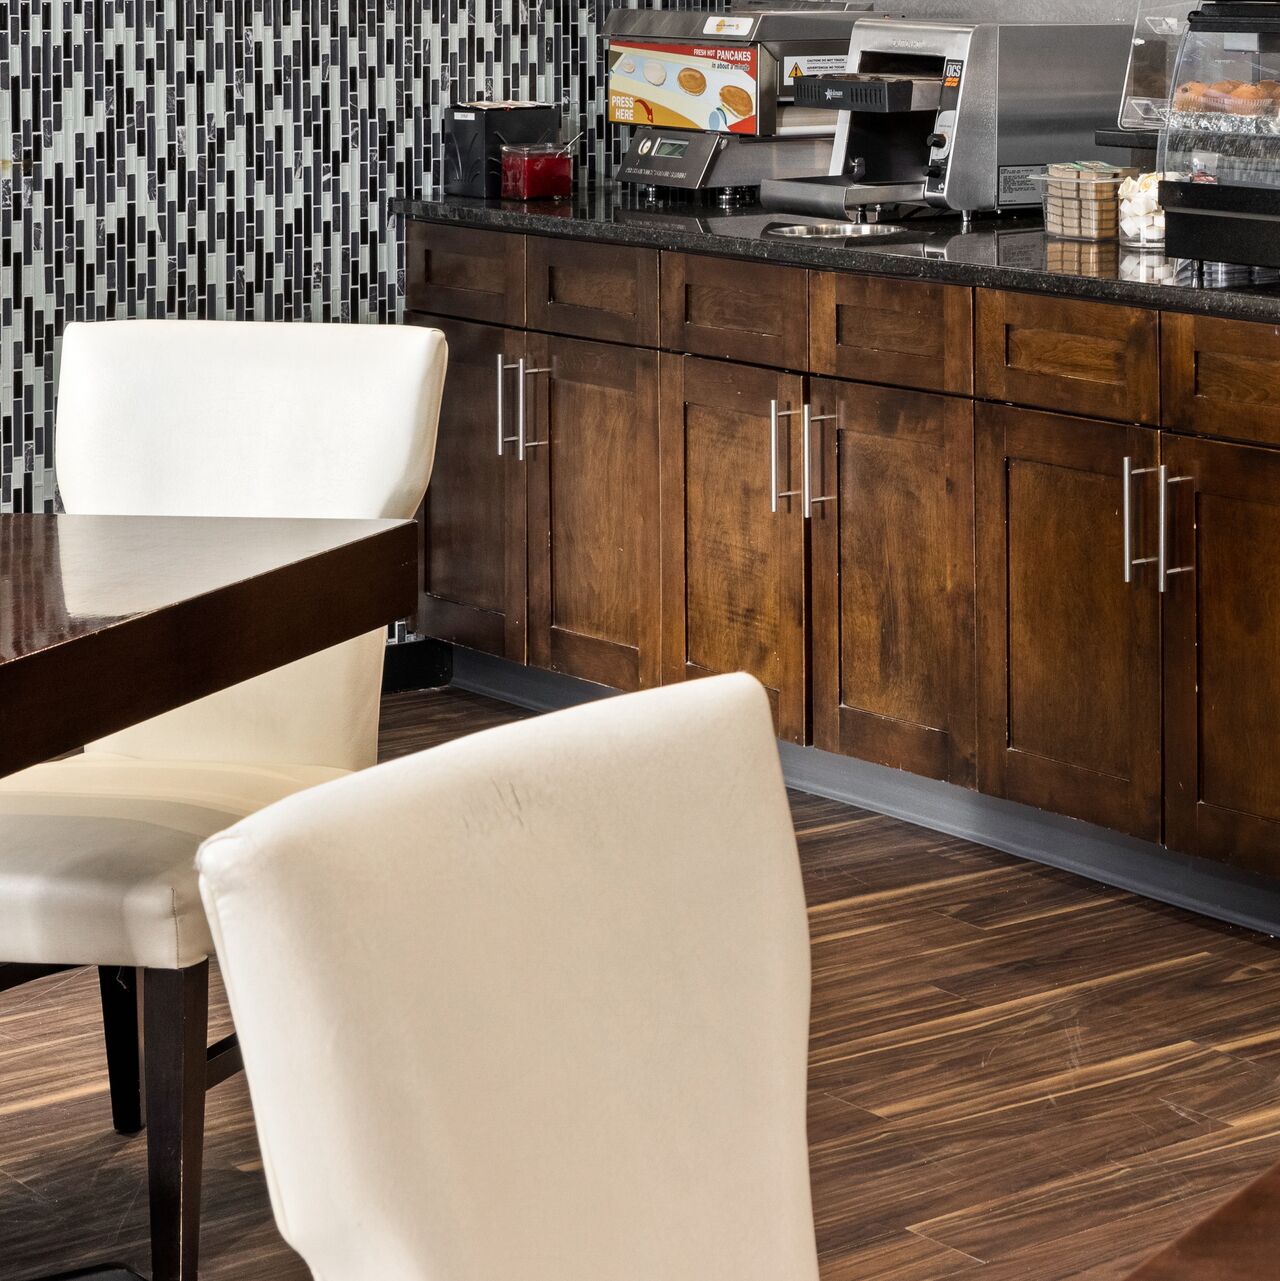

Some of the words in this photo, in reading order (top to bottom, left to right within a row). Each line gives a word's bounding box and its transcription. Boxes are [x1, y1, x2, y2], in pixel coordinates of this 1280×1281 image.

[717, 50, 752, 61] PANCAKES
[717, 62, 730, 70] about
[612, 95, 634, 108] PRESS
[615, 109, 634, 120] HERE
